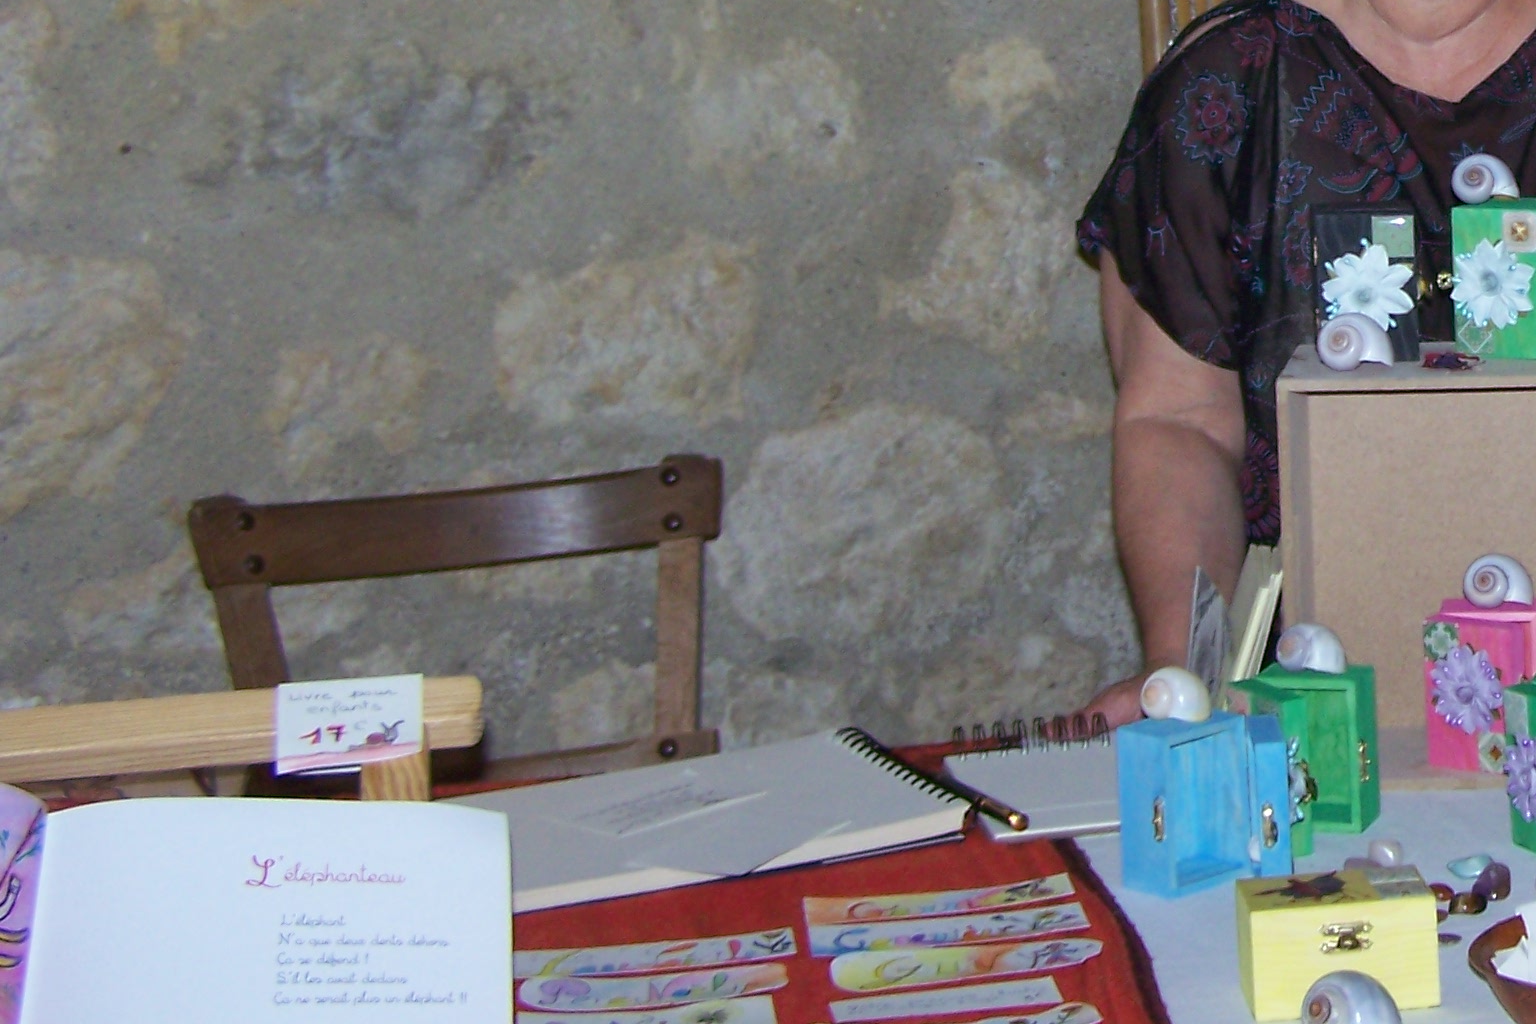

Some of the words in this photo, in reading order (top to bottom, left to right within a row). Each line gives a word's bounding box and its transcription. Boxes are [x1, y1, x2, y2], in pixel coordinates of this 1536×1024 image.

[306, 700, 382, 715] enfants
[299, 725, 346, 744] 17
[245, 854, 407, 888] L'éléphanteau
[309, 938, 330, 948] que
[336, 933, 366, 946] deux
[371, 933, 403, 946] dents
[353, 991, 380, 1006] plus
